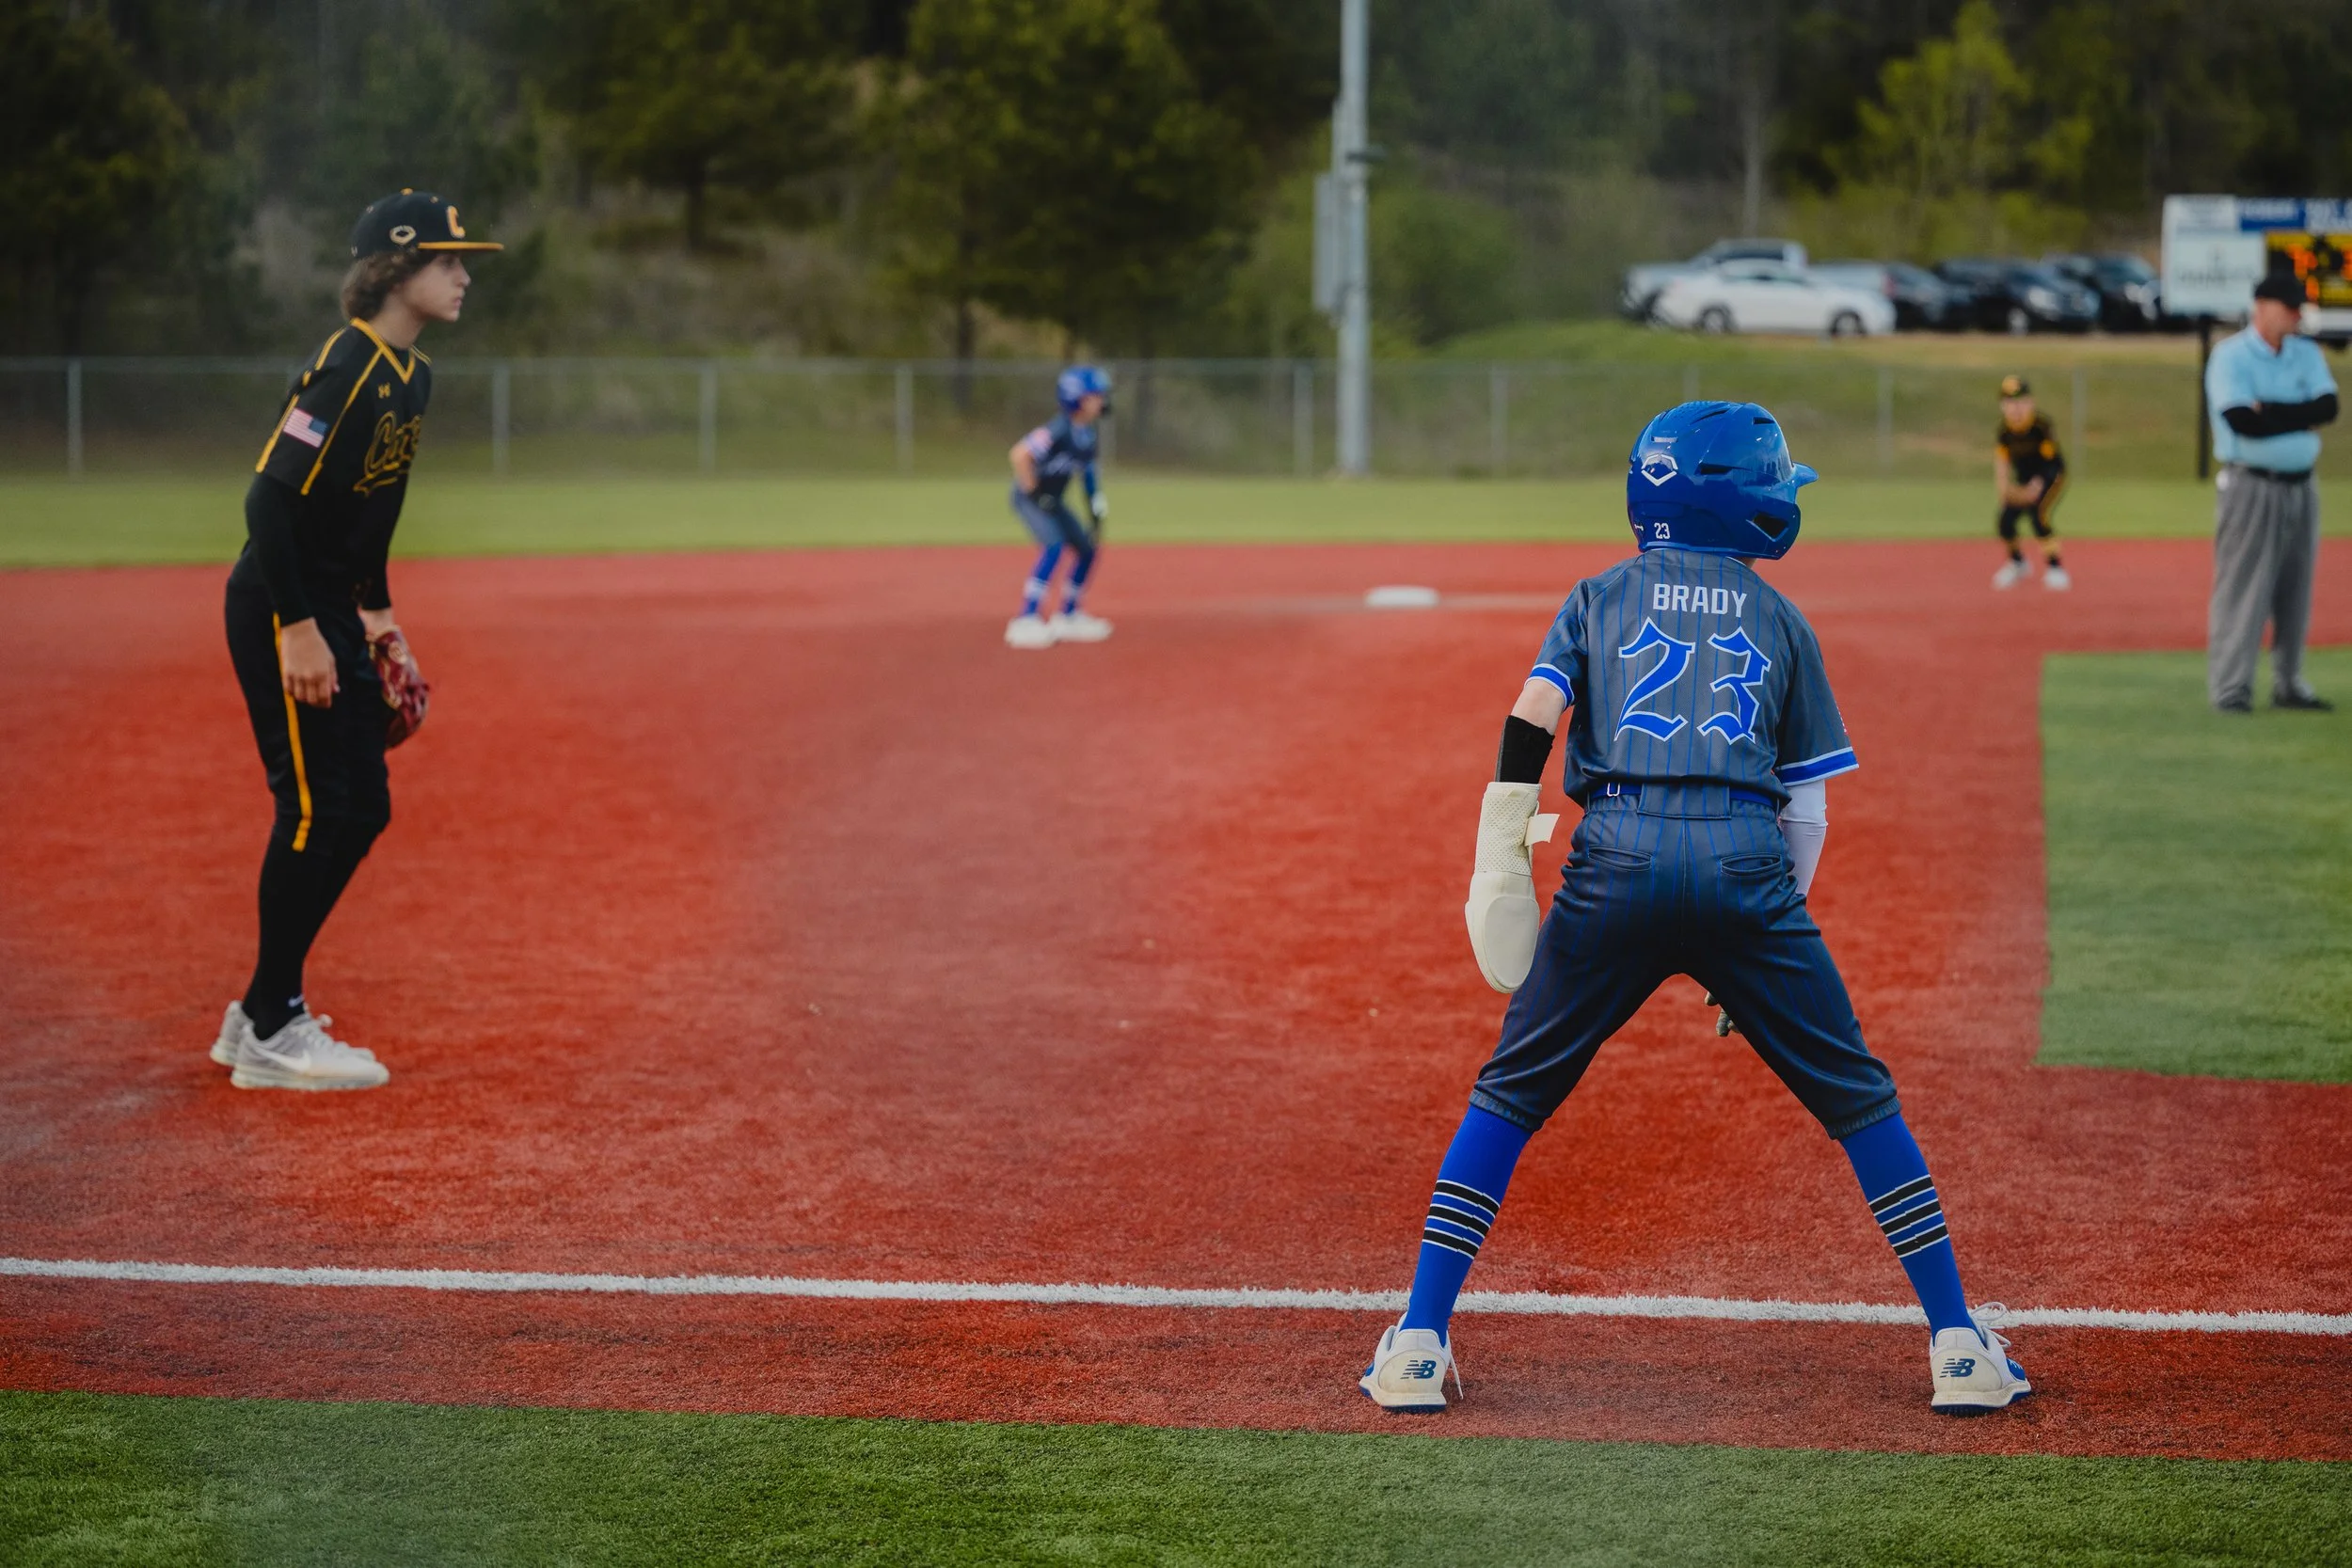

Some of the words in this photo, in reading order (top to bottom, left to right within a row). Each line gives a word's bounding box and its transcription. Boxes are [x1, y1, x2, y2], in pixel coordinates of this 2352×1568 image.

[1654, 522, 1671, 540] 23
[1651, 582, 1748, 617] BRADY
[1613, 616, 1772, 746] 23
